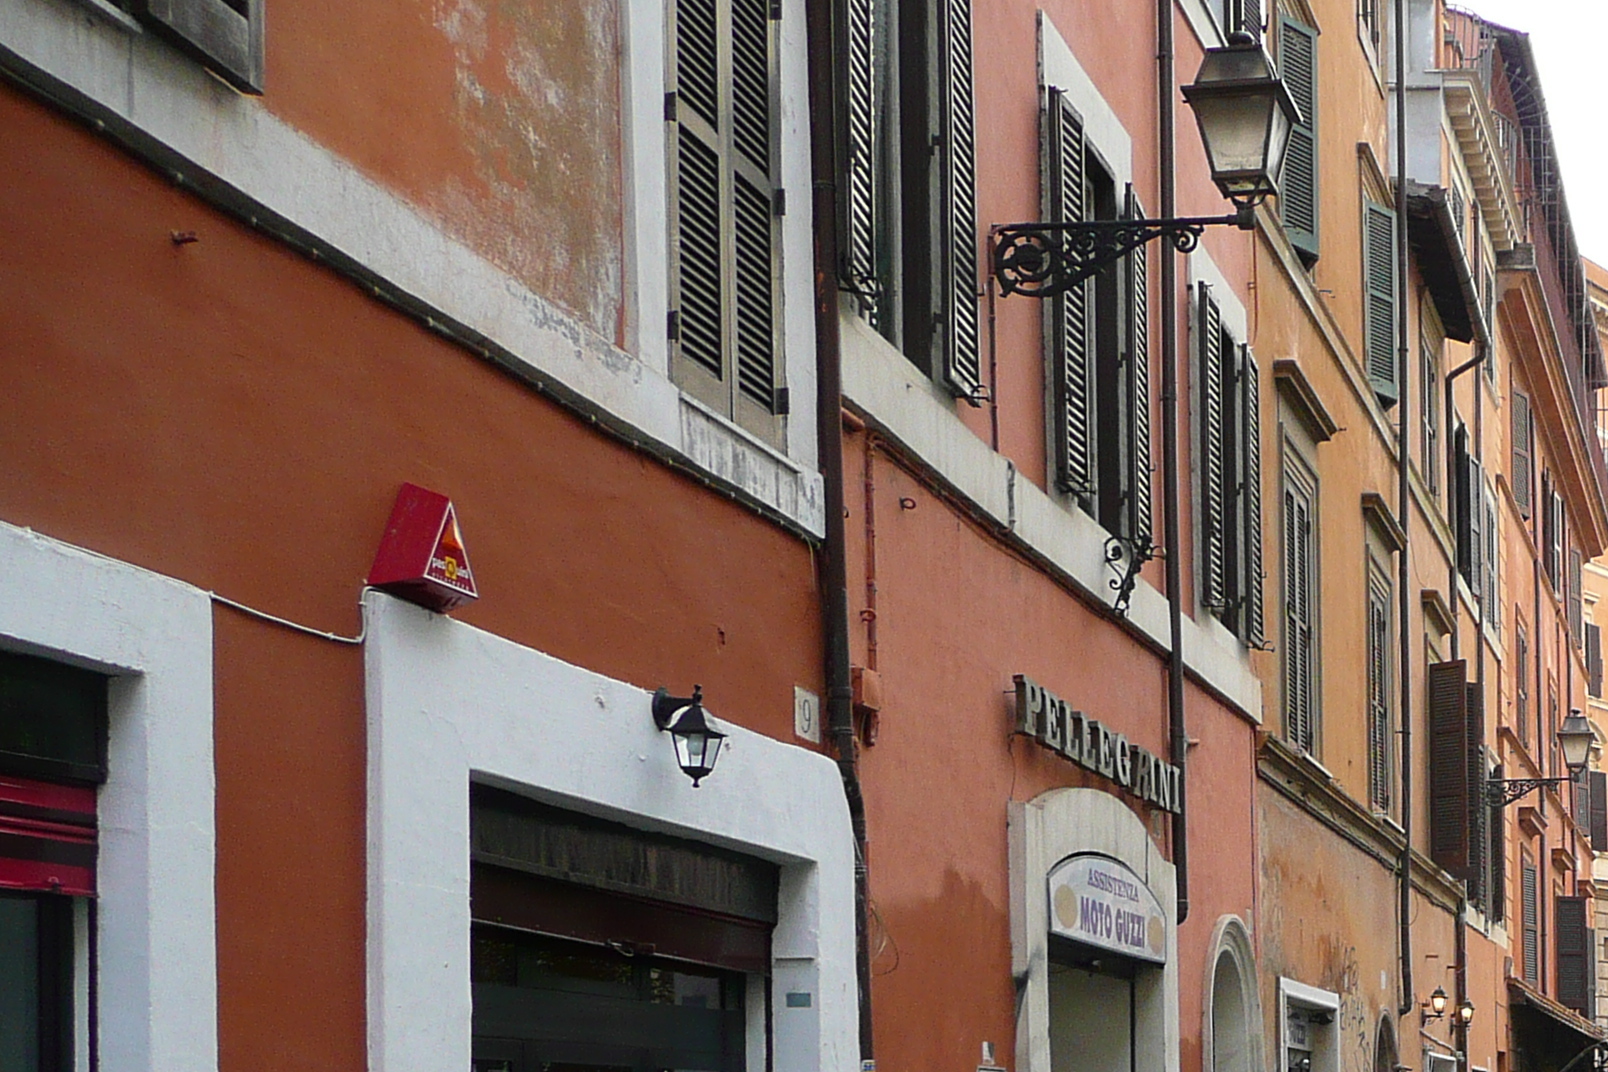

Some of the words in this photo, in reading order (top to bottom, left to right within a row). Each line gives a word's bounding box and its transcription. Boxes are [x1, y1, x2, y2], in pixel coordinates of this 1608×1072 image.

[801, 698, 811, 733] 9
[1013, 675, 1181, 814] PELLEGRINI
[1087, 868, 1140, 903] ASSISTENZA
[1080, 896, 1113, 939] MOTO
[1115, 908, 1145, 948] GUZZI
